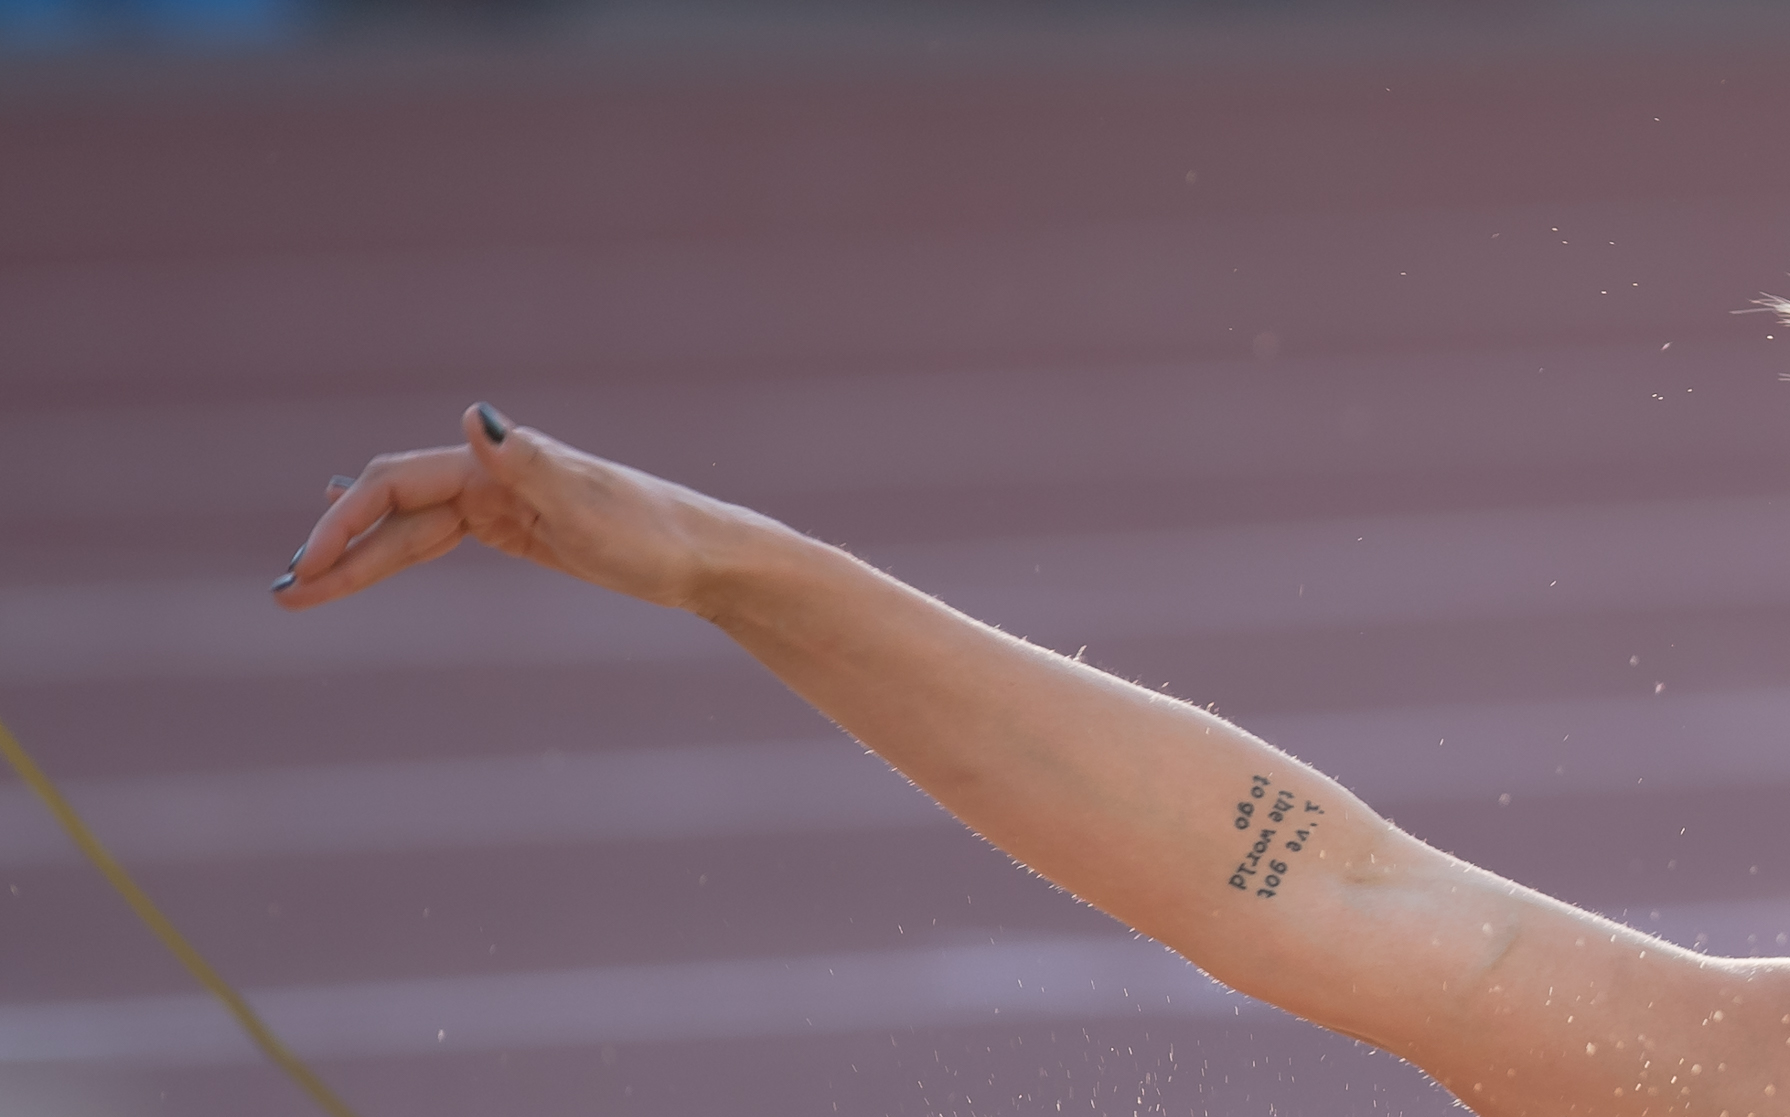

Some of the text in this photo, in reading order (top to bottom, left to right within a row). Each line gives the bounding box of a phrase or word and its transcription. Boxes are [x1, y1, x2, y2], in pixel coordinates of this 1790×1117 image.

[1234, 775, 1271, 830] to go
[1228, 790, 1295, 890] the world
[1257, 859, 1288, 898] got
